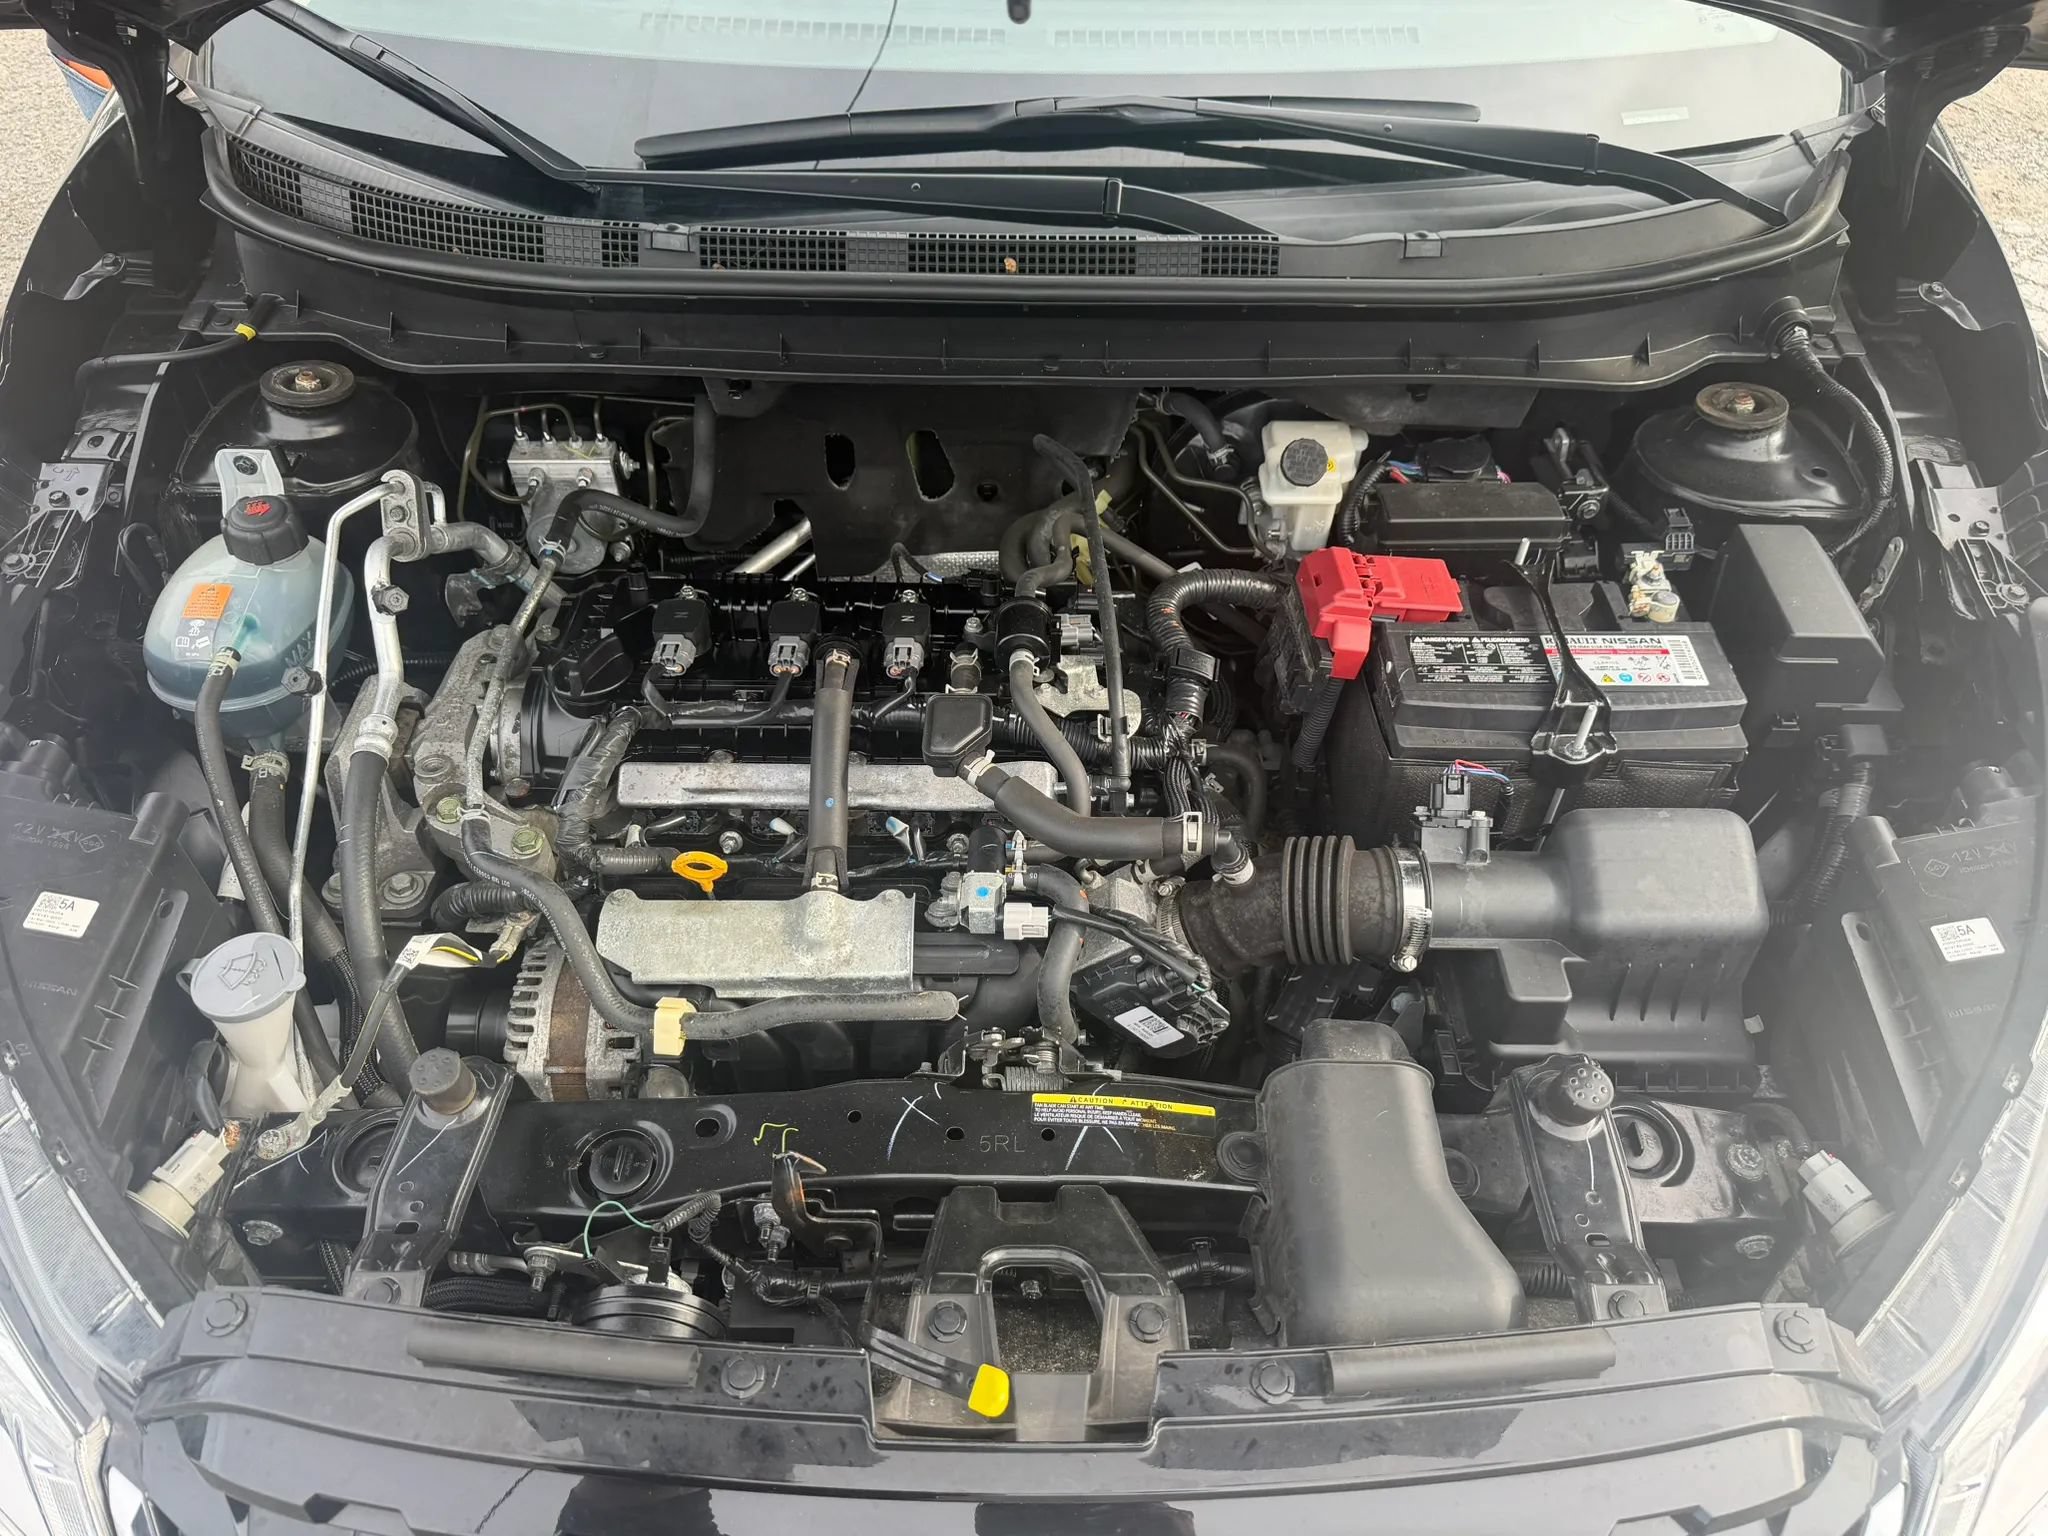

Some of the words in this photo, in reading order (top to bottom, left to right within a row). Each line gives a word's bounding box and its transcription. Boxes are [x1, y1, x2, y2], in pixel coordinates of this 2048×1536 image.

[1602, 637, 1662, 645] NISSAN
[284, 631, 314, 668] MAX
[58, 898, 76, 912] 5A
[1956, 924, 1976, 937] 5A
[1130, 1101, 1173, 1109] ATTENTION
[979, 1134, 1025, 1153] 5RL
